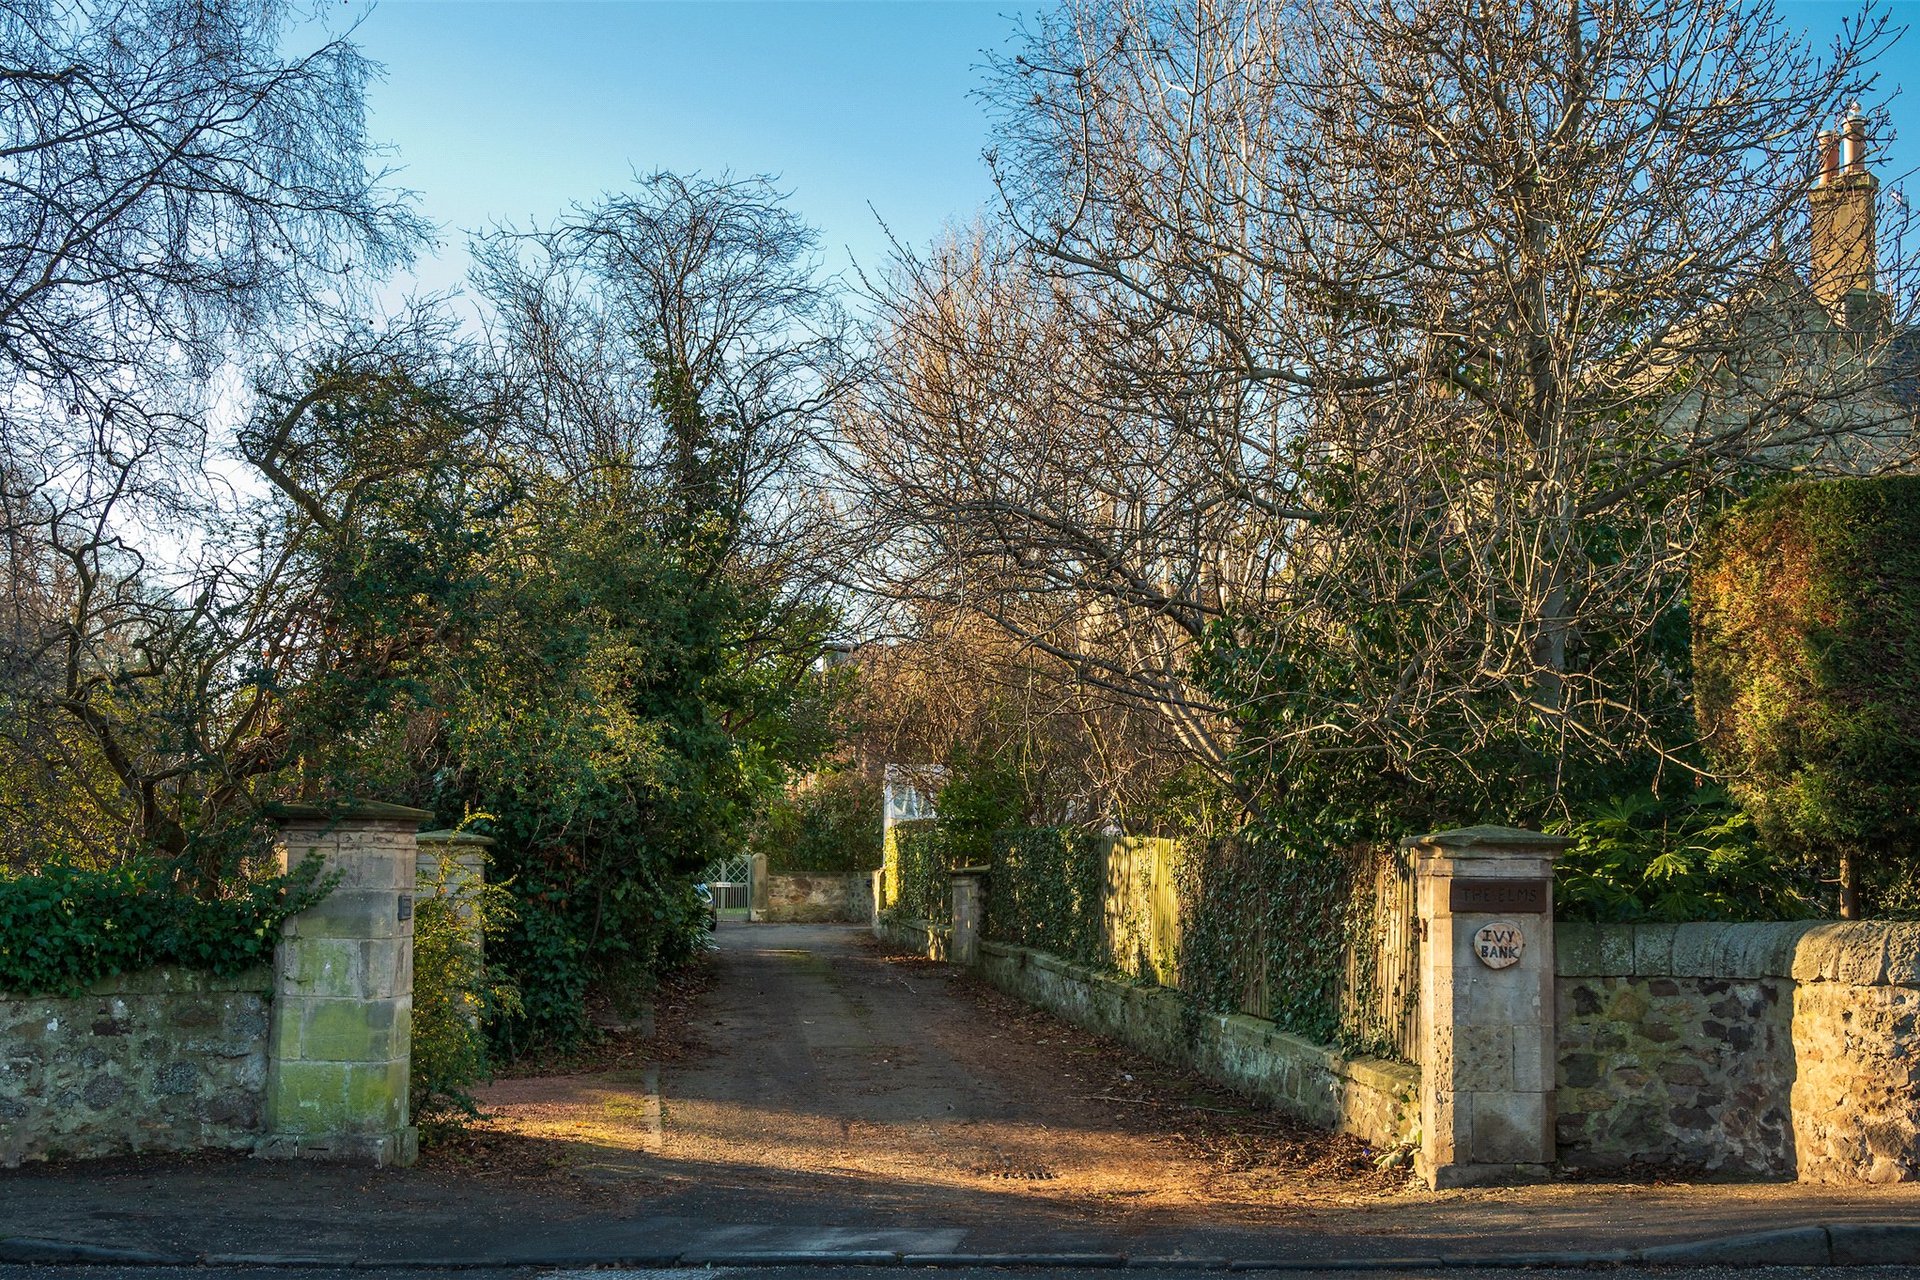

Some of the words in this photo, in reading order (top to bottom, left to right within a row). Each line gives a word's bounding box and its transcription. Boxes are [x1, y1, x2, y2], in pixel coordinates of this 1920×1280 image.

[1461, 888, 1491, 902] THE
[1499, 888, 1537, 902] ELMS
[1482, 930, 1515, 943] IVY
[1481, 945, 1520, 959] BANK
